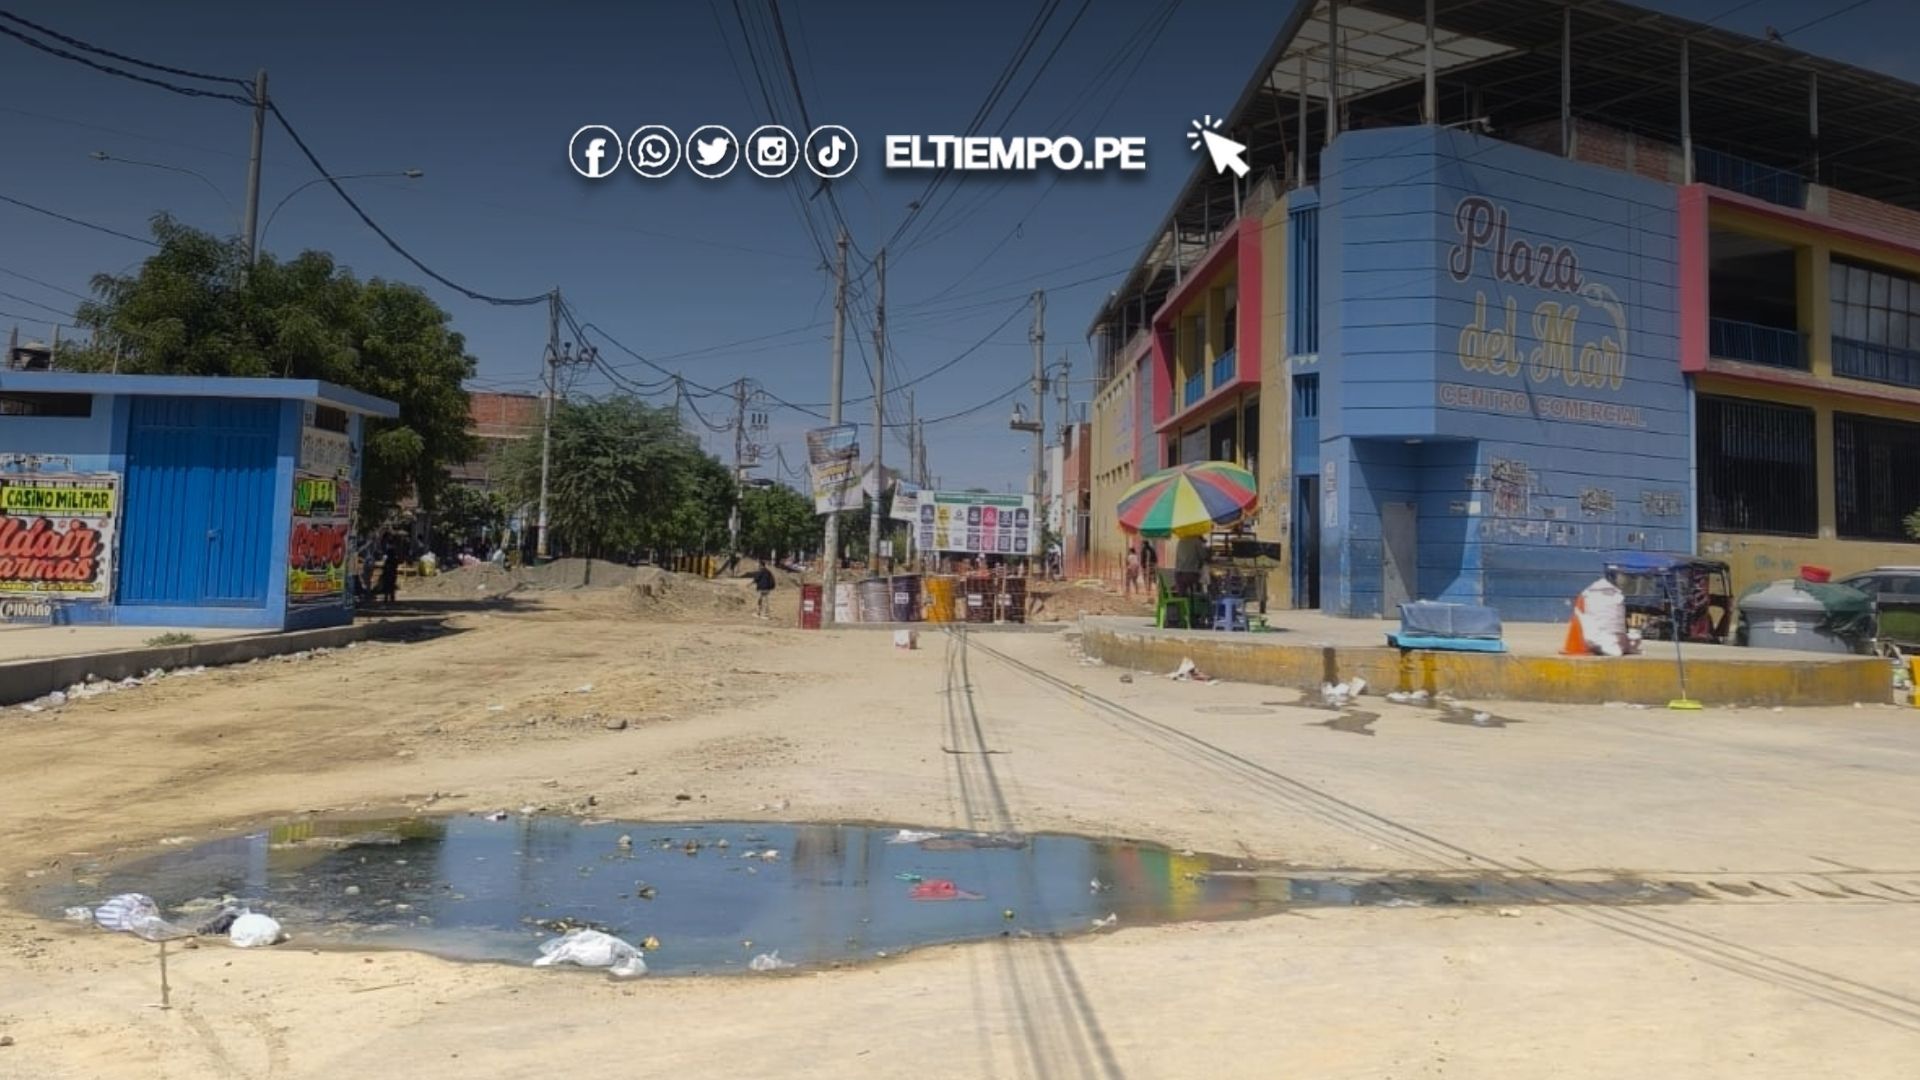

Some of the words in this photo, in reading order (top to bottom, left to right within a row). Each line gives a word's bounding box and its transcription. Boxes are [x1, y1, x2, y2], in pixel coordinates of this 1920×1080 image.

[1448, 195, 1583, 294] Plaza
[1458, 290, 1523, 378] del
[1529, 300, 1626, 391] Mar
[1440, 383, 1529, 413] CENTRO
[1537, 398, 1647, 428] COMERCIAL
